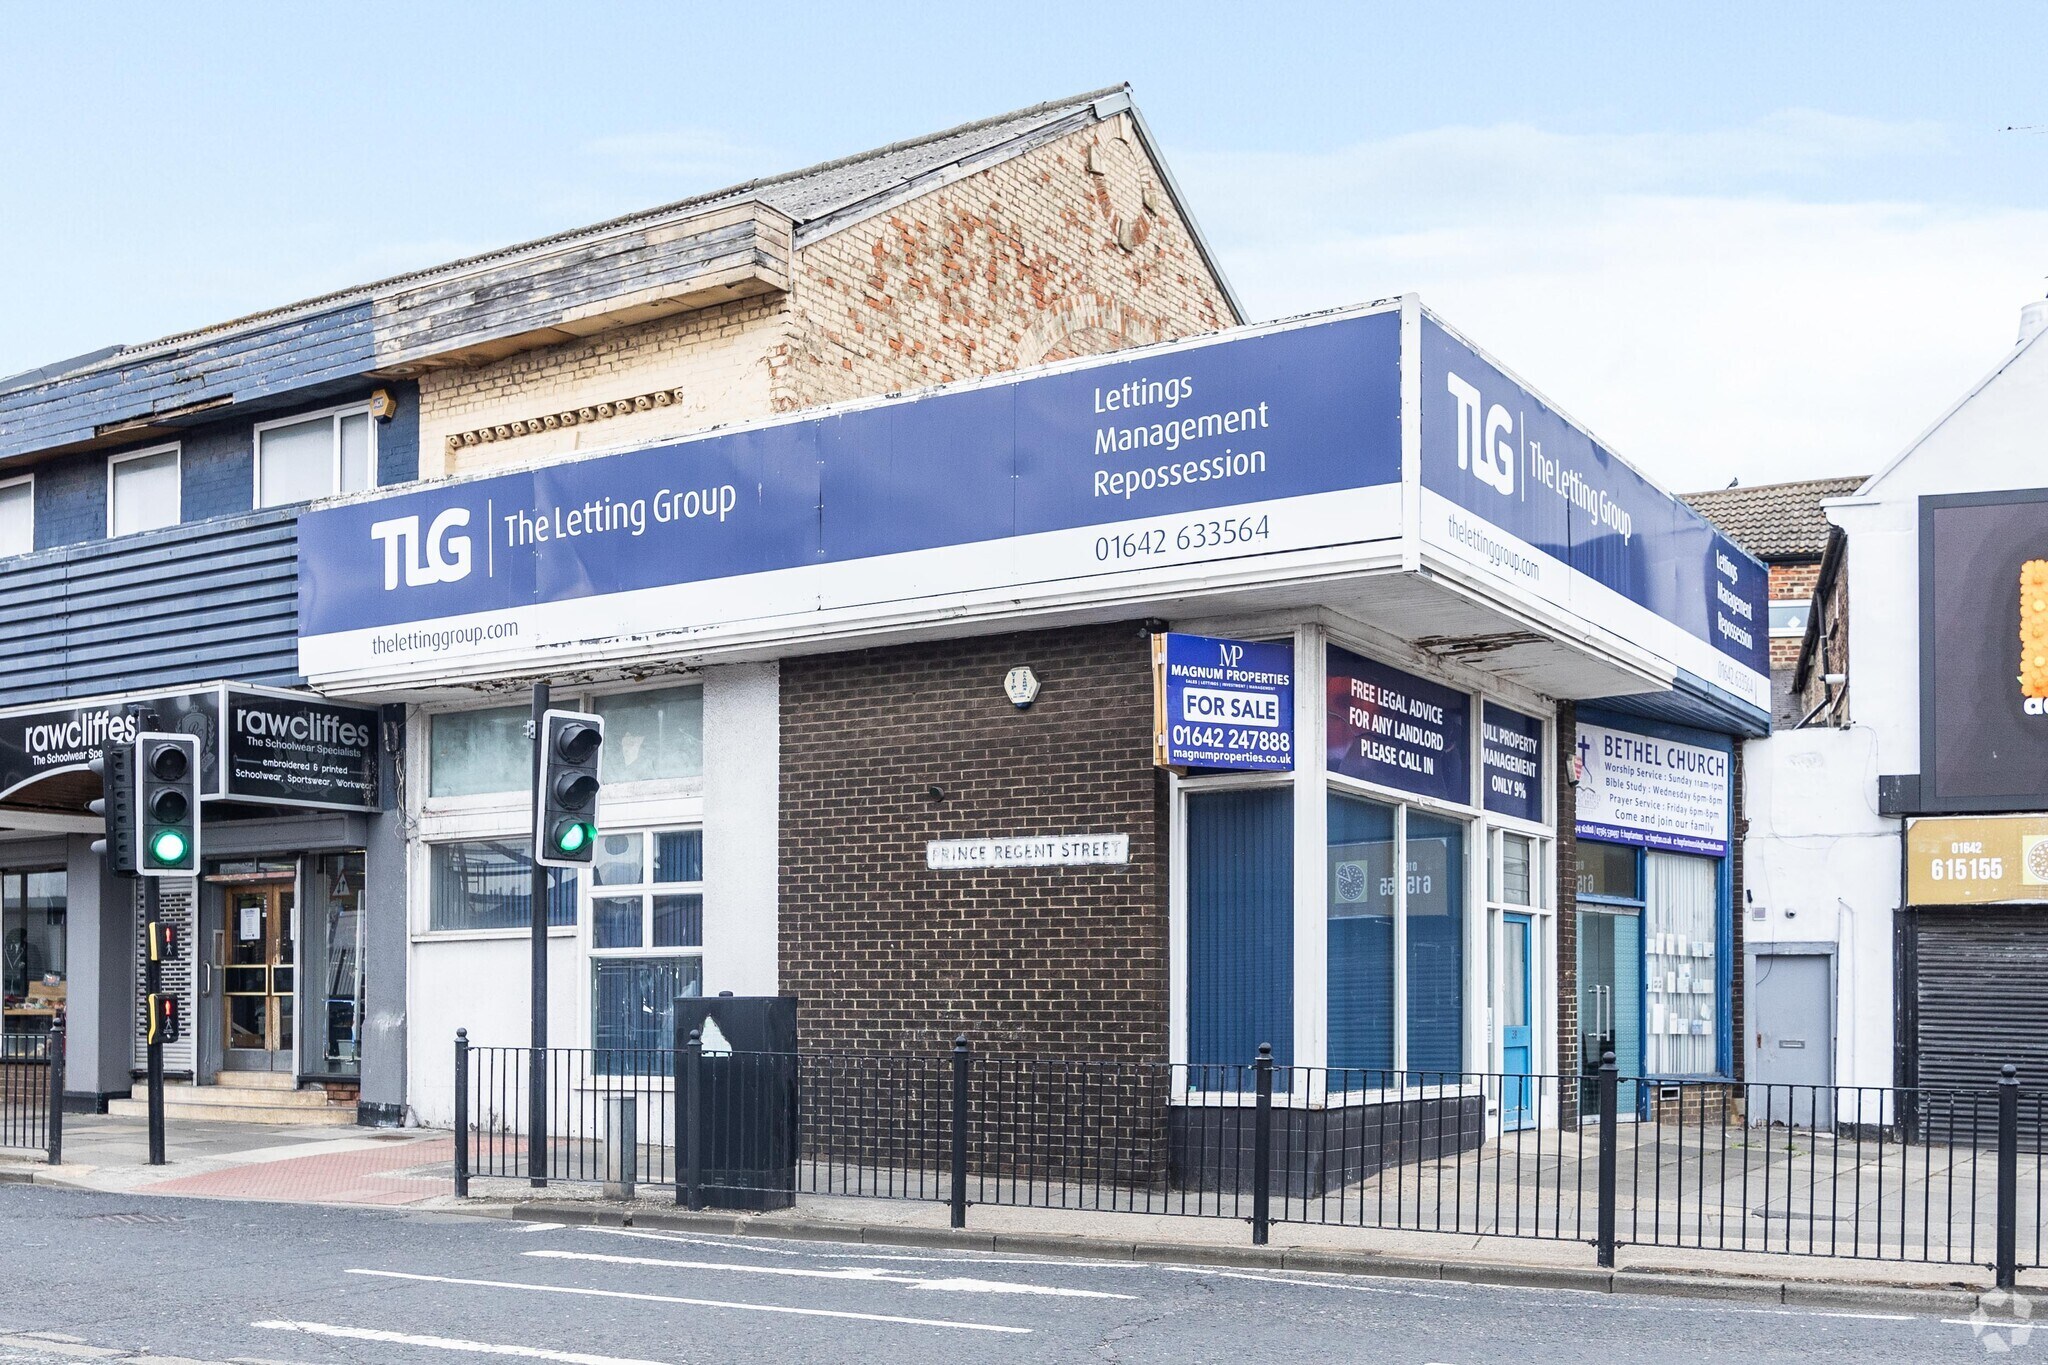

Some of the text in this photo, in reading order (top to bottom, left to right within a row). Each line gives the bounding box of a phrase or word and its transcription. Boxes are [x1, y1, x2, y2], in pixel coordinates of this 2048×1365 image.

[1095, 376, 1193, 413] Lettings
[1094, 401, 1269, 455] Management
[1447, 371, 1514, 495] TLG
[1094, 449, 1266, 500] Repossession
[1529, 440, 1631, 546] The Letting Group
[504, 484, 736, 547] The Letting Group
[370, 507, 472, 590] TLG
[1095, 514, 1270, 561] 01642 633564
[1448, 513, 1540, 580] thelettinggroup.com
[1716, 549, 1738, 585] Lettings
[1717, 580, 1753, 621] Management
[372, 620, 518, 655] thelettinggroup.com
[1717, 611, 1753, 650] Repossession
[1219, 643, 1243, 668] MP
[1171, 664, 1290, 686] MAGNUM PROPERTIES
[1187, 695, 1276, 720] FOR SALE
[1351, 678, 1443, 725] FREE LEGAL ADVICE
[25, 710, 136, 753] rawcliffes
[237, 708, 369, 747] rawcliffes
[1173, 724, 1290, 752] 01642 247888
[1349, 706, 1444, 751] FOR ANY LANDLORD
[1483, 723, 1537, 755] ULL PROPERTY
[32, 755, 46, 766] The
[46, 751, 87, 765] Schoolwear
[246, 735, 361, 758] The Schoolwear Specialists
[1173, 749, 1291, 764] magnumproperties.co.uk
[1360, 738, 1434, 775] PLEASE CALL IN
[1482, 746, 1536, 778] MANAGEMENT
[1604, 735, 1724, 778] BETHEL CHURCH
[235, 768, 284, 783] Schoolwear,
[287, 774, 333, 787] Sportswear,
[262, 758, 310, 771] embroidered
[321, 764, 348, 774] printed
[1604, 762, 1635, 777] Worship
[1637, 767, 1662, 781] Service
[1669, 773, 1692, 787] Sunday
[1492, 774, 1527, 799] ONLY 9%
[1605, 777, 1624, 789] Bible
[1626, 780, 1646, 795] Study
[1653, 786, 1691, 801] Wednesday
[1609, 793, 1632, 806] Prayer
[1635, 798, 1660, 810] Service
[1667, 803, 1687, 815] Friday
[1615, 809, 1714, 835] Come and join our family
[995, 843, 1055, 859] REGENT
[1951, 842, 1982, 854] 01642
[1931, 857, 2003, 881] 615155
